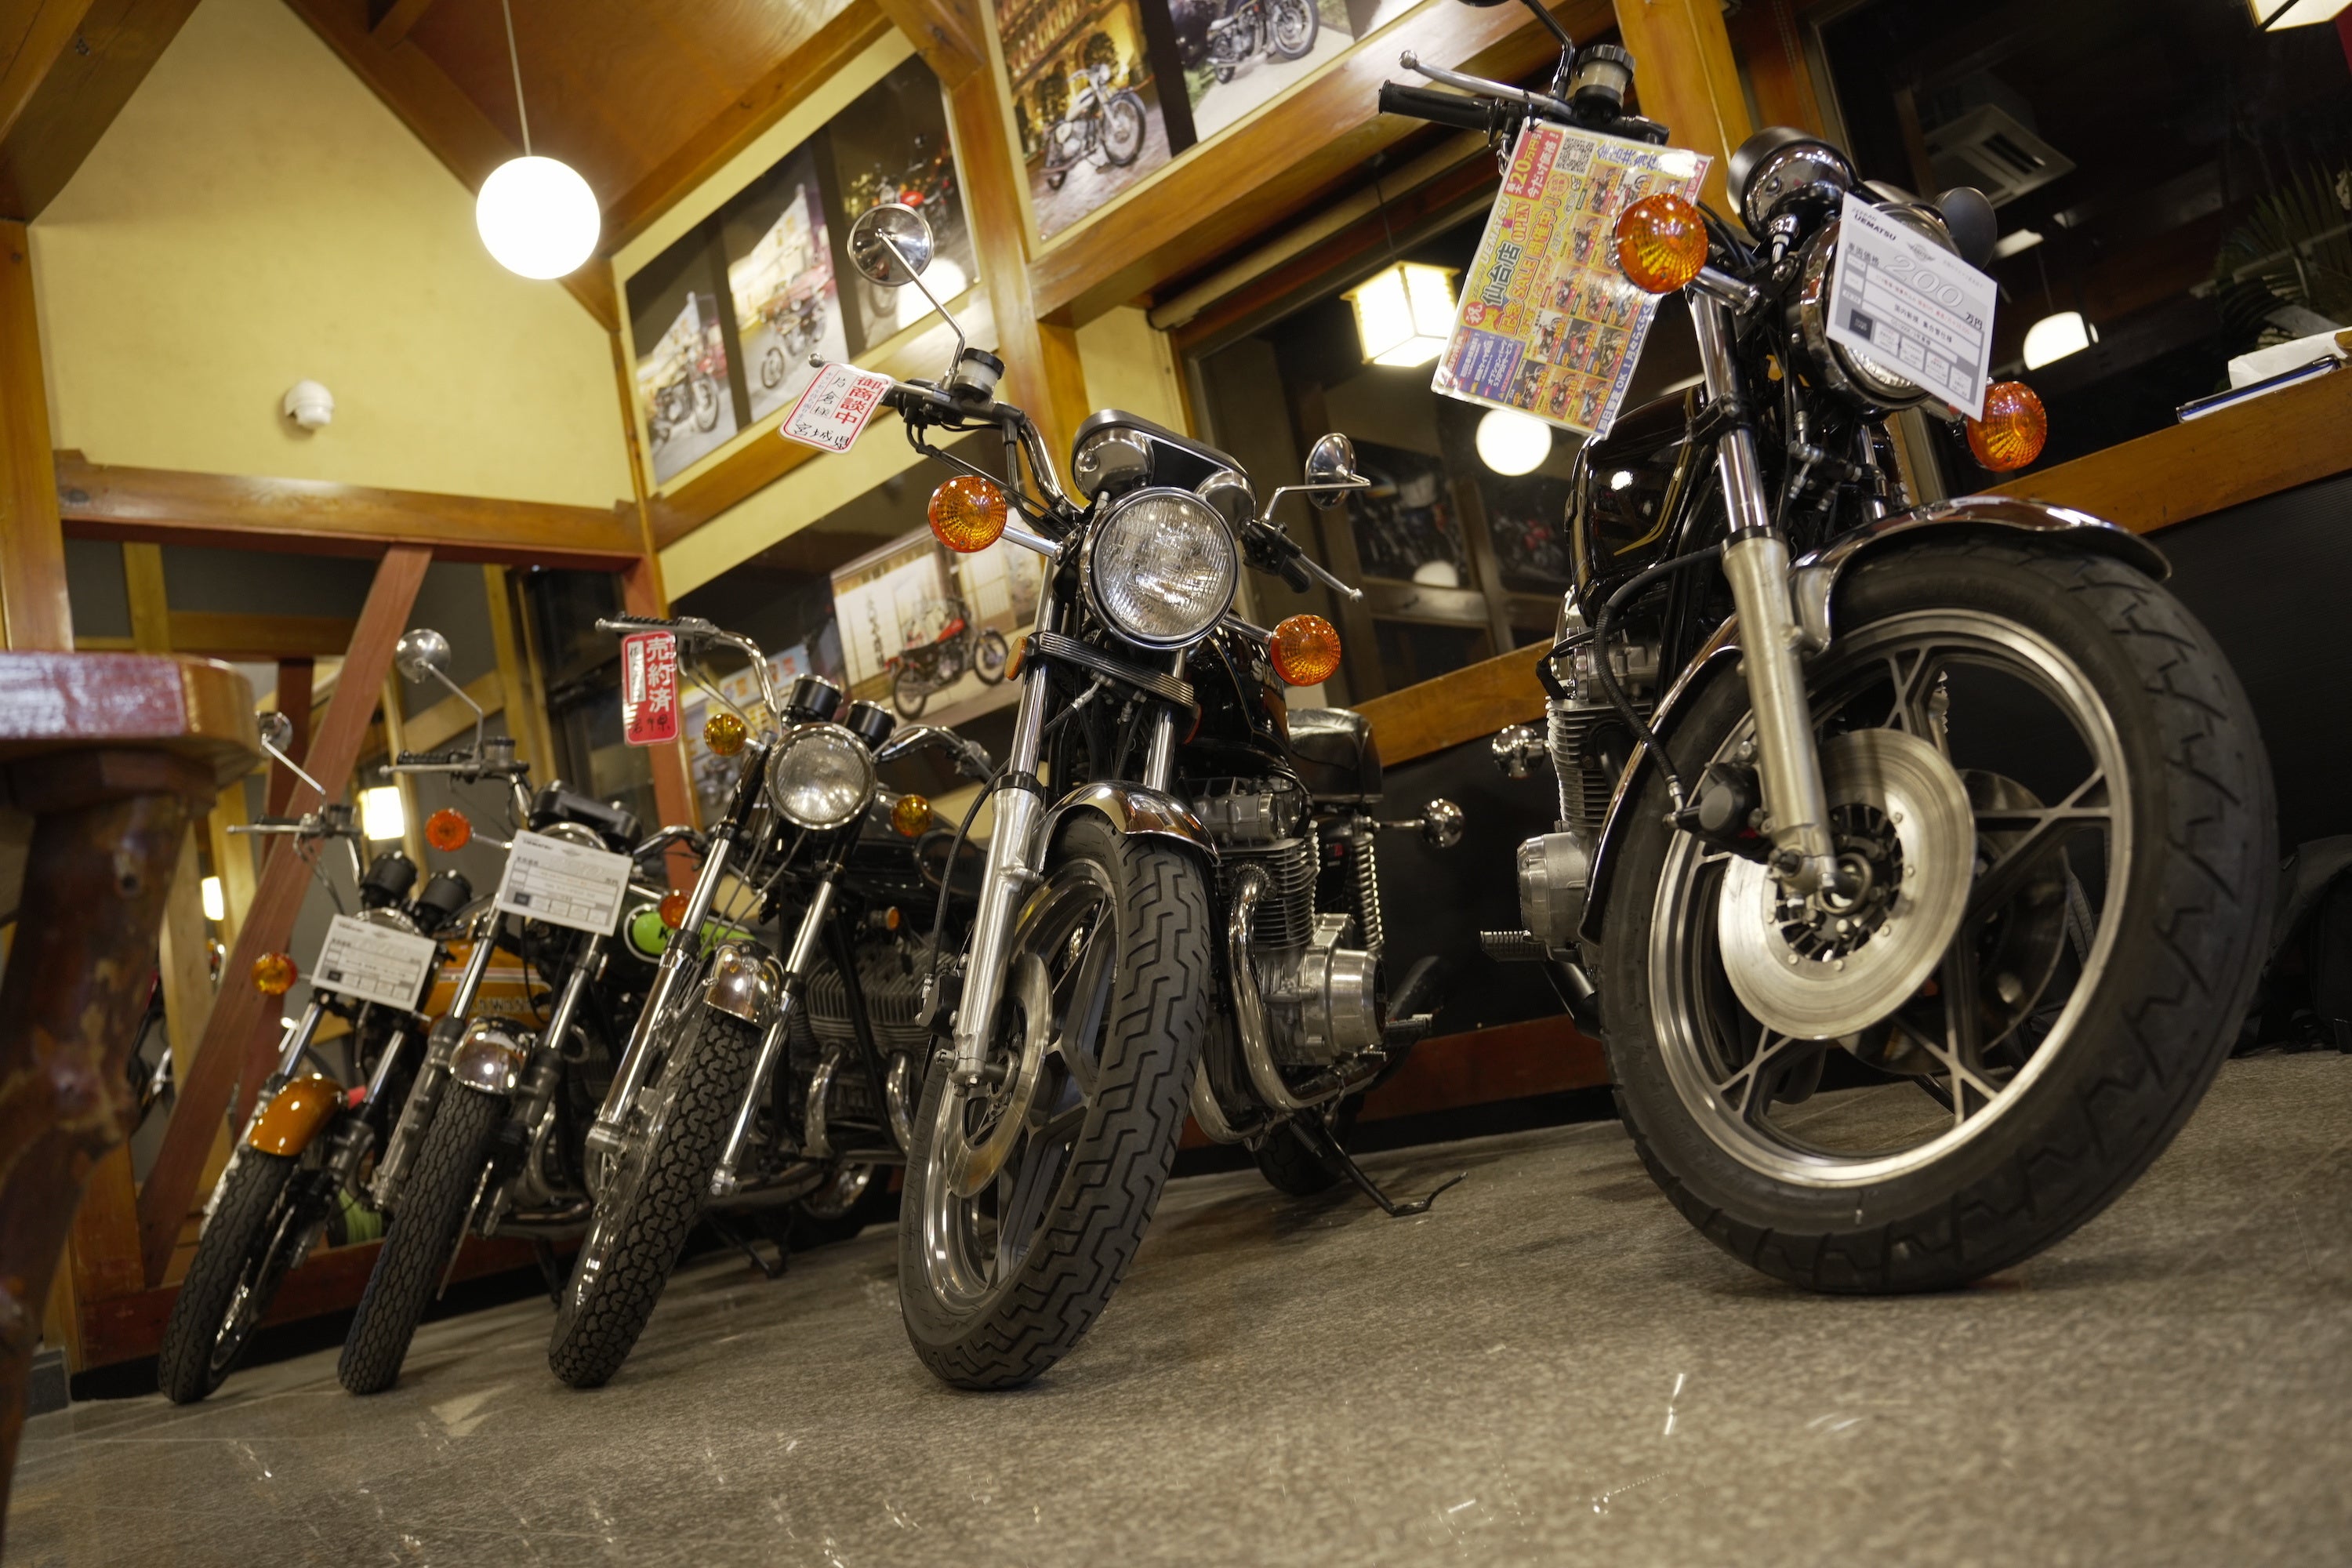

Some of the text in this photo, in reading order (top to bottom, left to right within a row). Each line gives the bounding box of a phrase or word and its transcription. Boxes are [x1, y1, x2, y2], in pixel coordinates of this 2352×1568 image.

[1483, 196, 1512, 264] UEMATSU
[1510, 201, 1532, 241] OPEN
[1854, 214, 1896, 242] UEMATSU
[1481, 240, 1522, 307] 仙台店
[1499, 299, 1523, 336] 記念
[1513, 256, 1538, 299] SALE
[1884, 255, 1964, 309] 200
[1965, 311, 1983, 330] 万円
[1464, 303, 1486, 324] 祝
[1552, 321, 1565, 339] 260
[835, 376, 884, 424] 御商談中
[793, 422, 849, 449] 宮城県
[647, 636, 674, 713] 売約済
